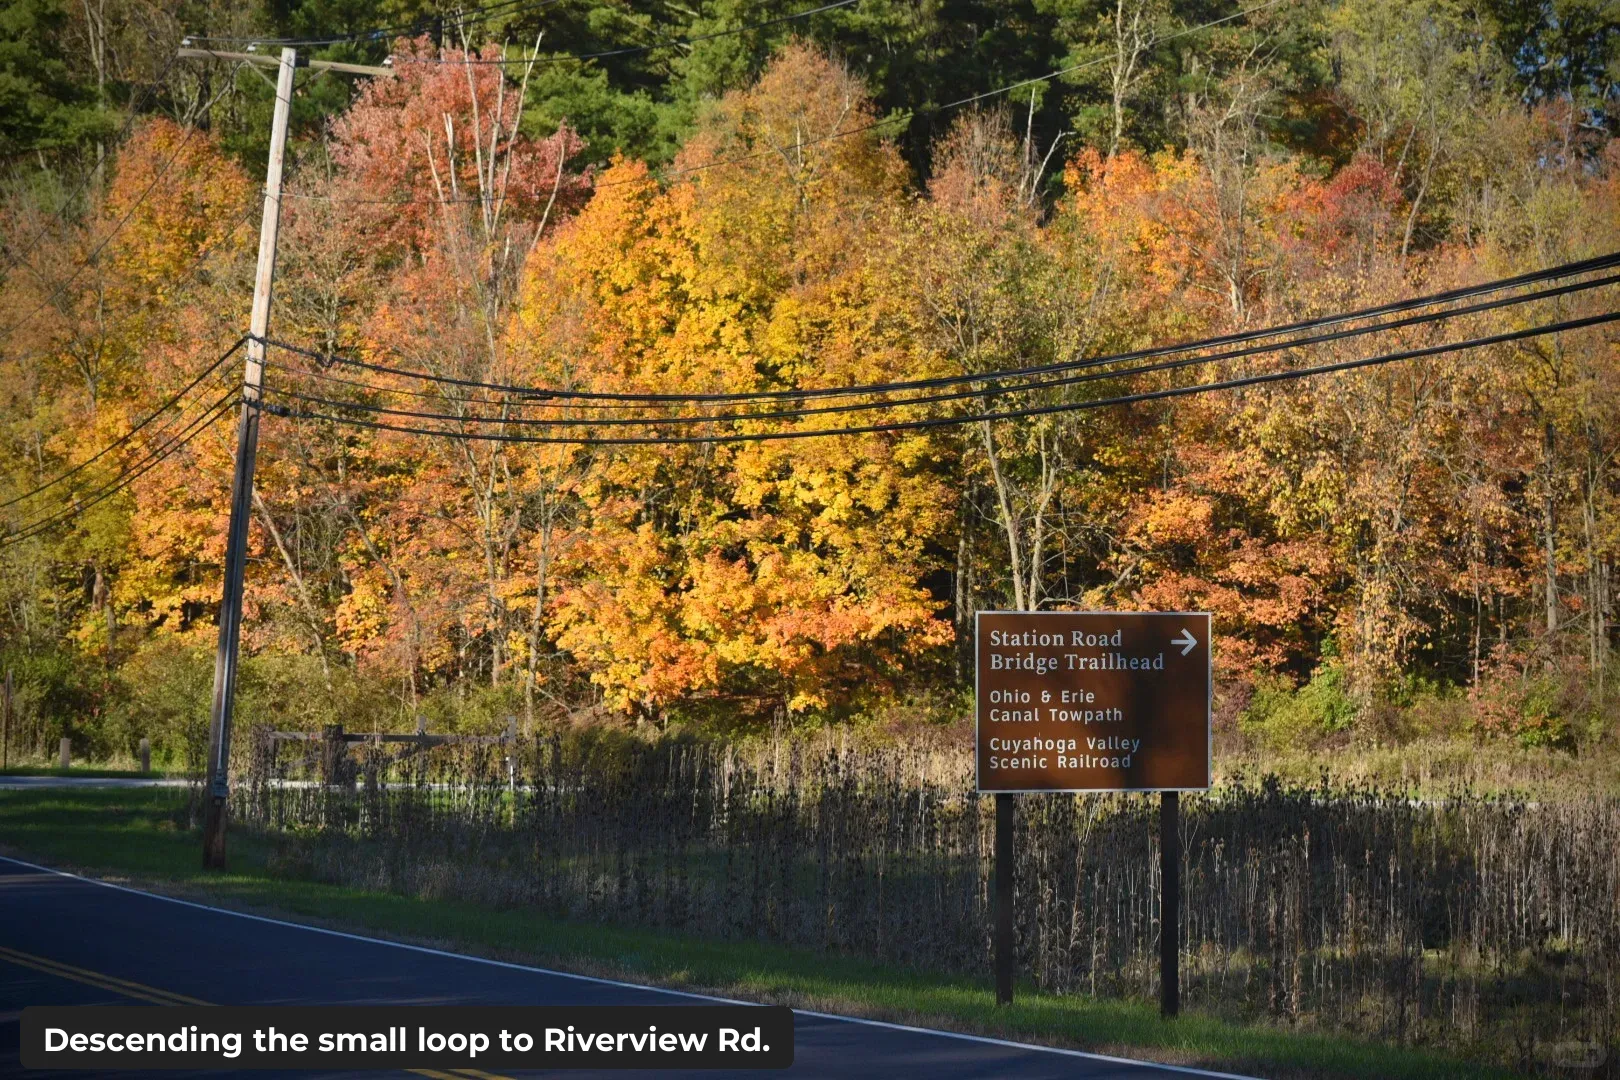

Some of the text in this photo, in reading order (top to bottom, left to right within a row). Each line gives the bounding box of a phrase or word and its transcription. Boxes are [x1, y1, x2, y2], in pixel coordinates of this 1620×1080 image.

[990, 629, 1123, 647] Station Road
[990, 652, 1165, 675] Bridge Trailhead
[989, 689, 1096, 704] Ohio & Erie
[989, 707, 1123, 725] Canal Towpath
[989, 736, 1140, 753] Cuyahoga Valley
[989, 754, 1131, 770] Scenic Railroad
